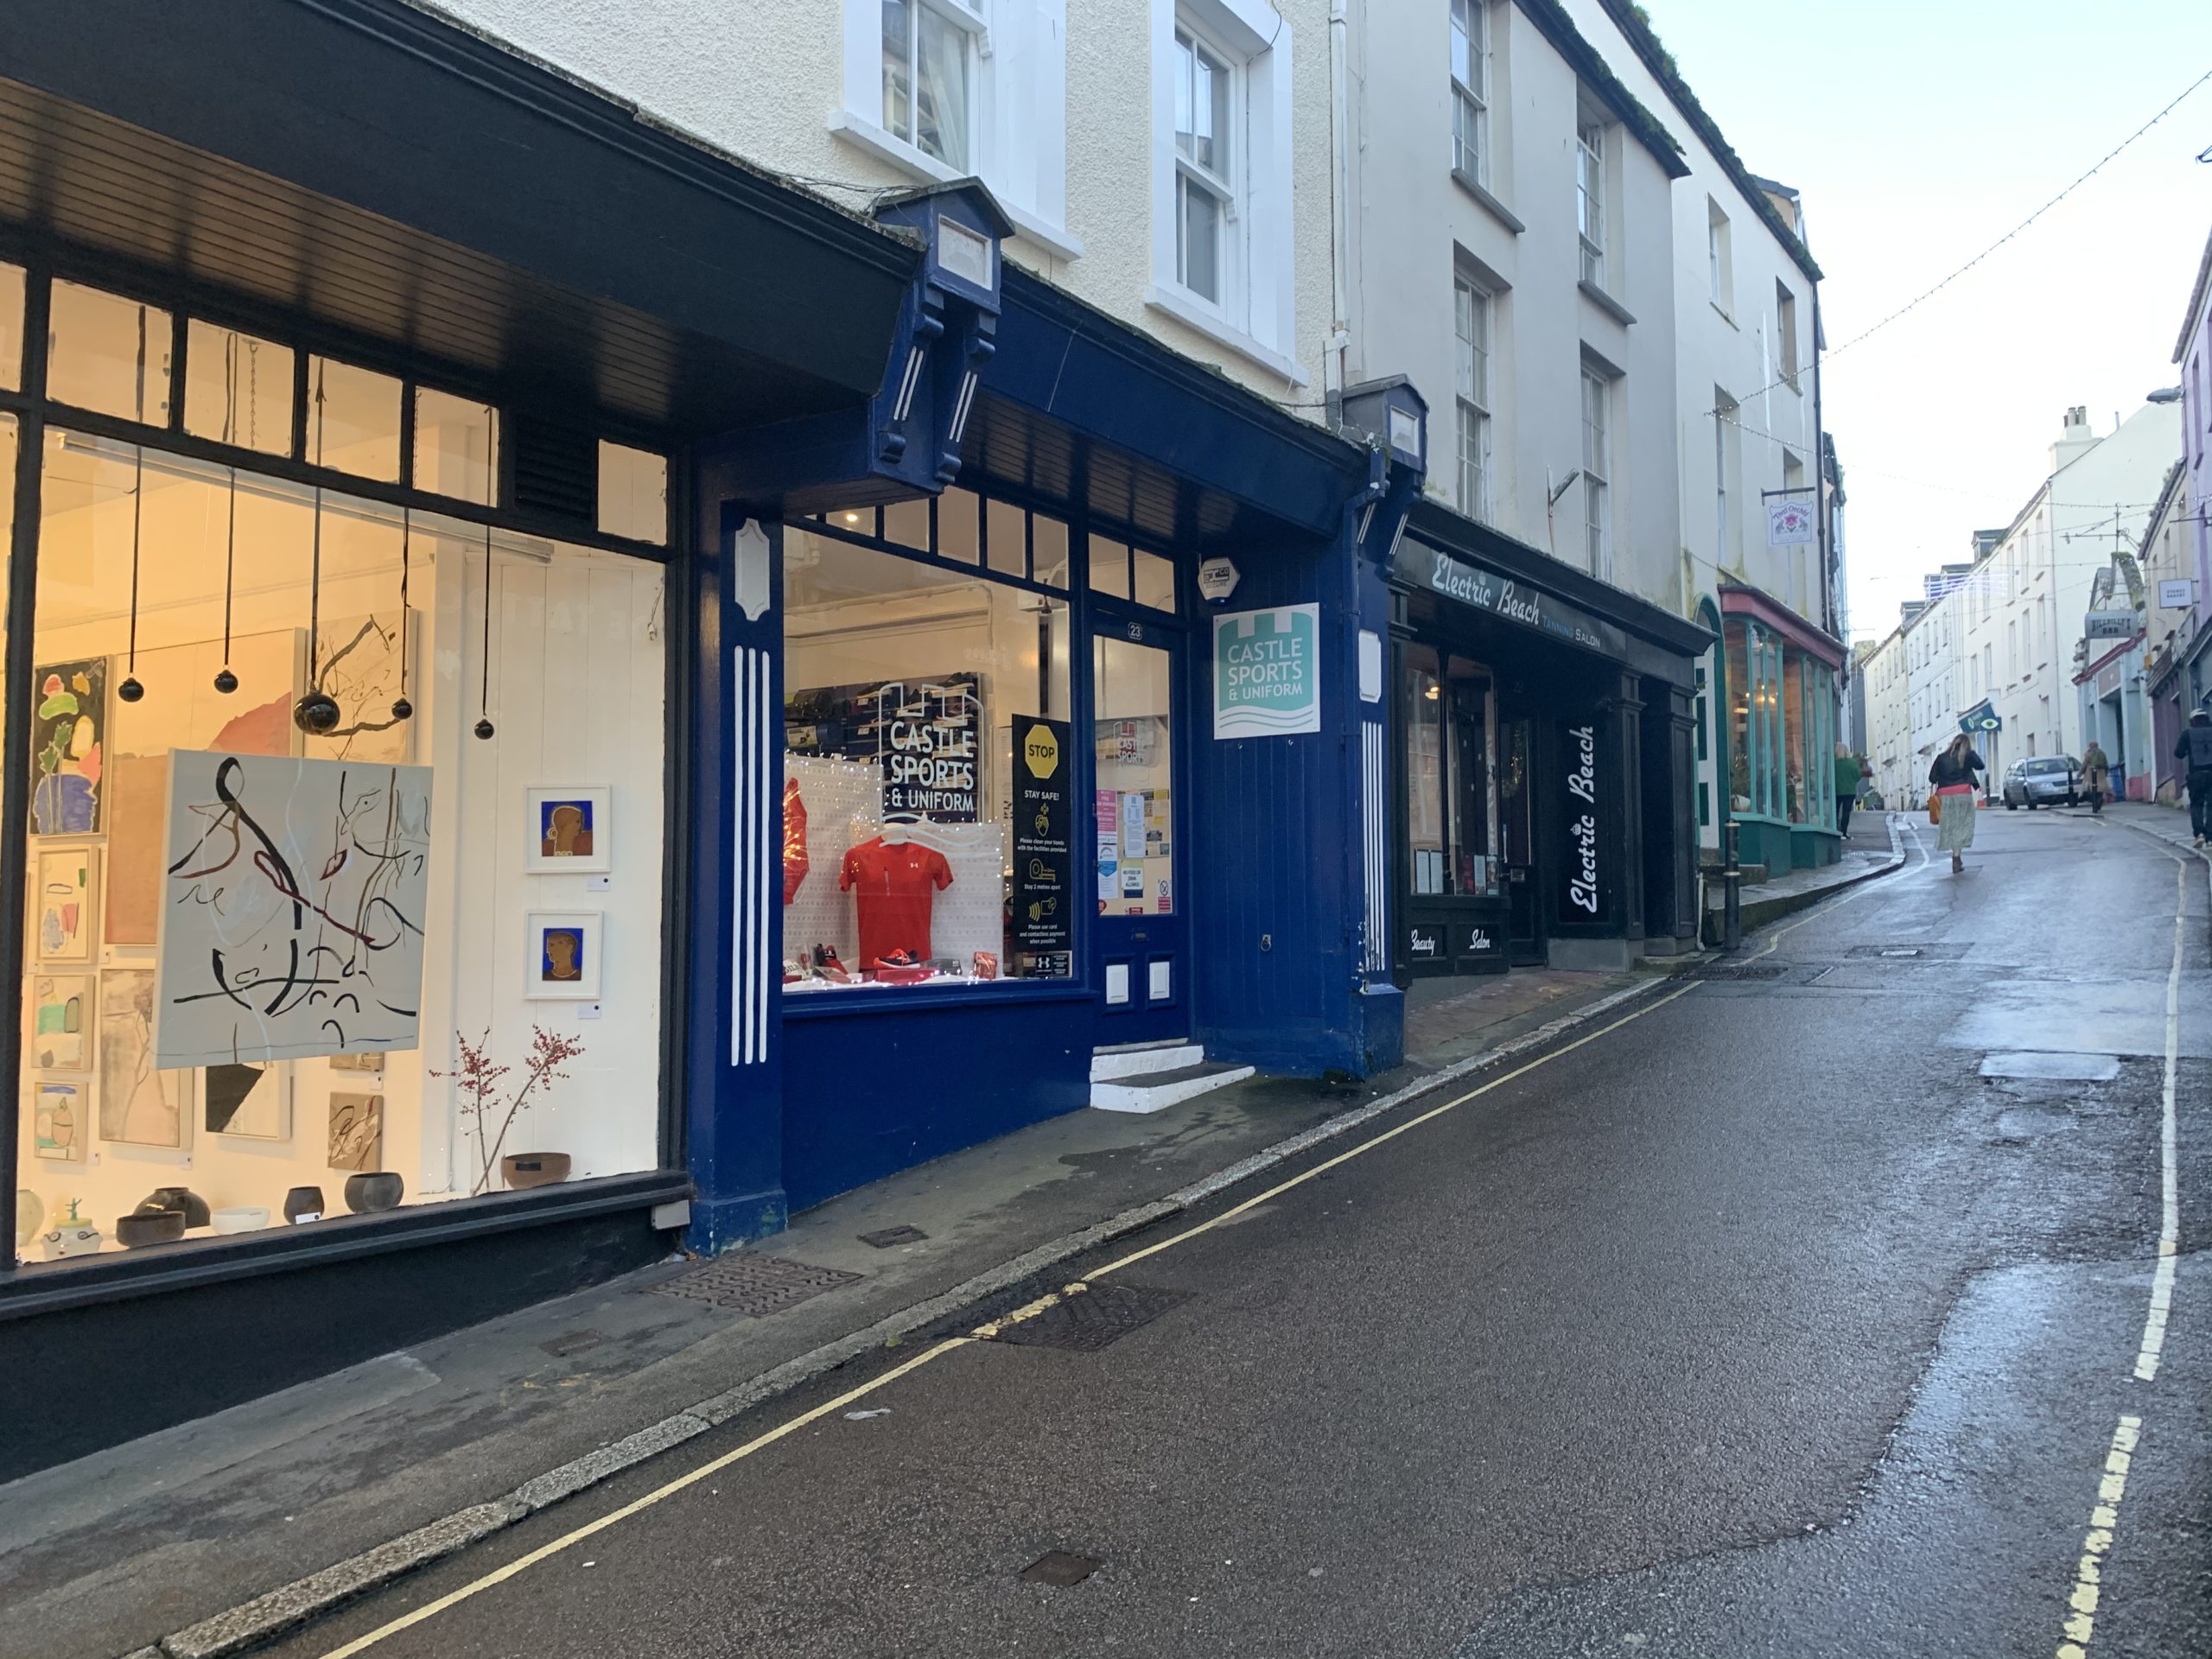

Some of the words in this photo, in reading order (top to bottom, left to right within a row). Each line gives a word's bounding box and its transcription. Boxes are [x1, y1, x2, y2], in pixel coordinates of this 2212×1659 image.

[1432, 552, 1491, 607] Electric
[1497, 579, 1540, 626] Beach
[1130, 625, 1141, 638] 23
[1227, 638, 1303, 664] CASTLE
[1228, 661, 1303, 686] SPORTS
[1229, 689, 1238, 701] &
[1243, 683, 1303, 700] UNIFORM
[890, 721, 974, 758] CASTLE
[1028, 744, 1055, 759] STOP
[1118, 751, 1142, 763] SPORT
[1567, 726, 1595, 804] Beach
[891, 754, 974, 791] SPORTS
[892, 787, 903, 808] &
[908, 789, 974, 812] UNIFORM
[1024, 790, 1039, 798] STAY
[1041, 791, 1059, 801] SAFE!
[1570, 815, 1598, 913] Electric
[1411, 929, 1435, 956] Beauty
[1469, 929, 1491, 950] Salon
